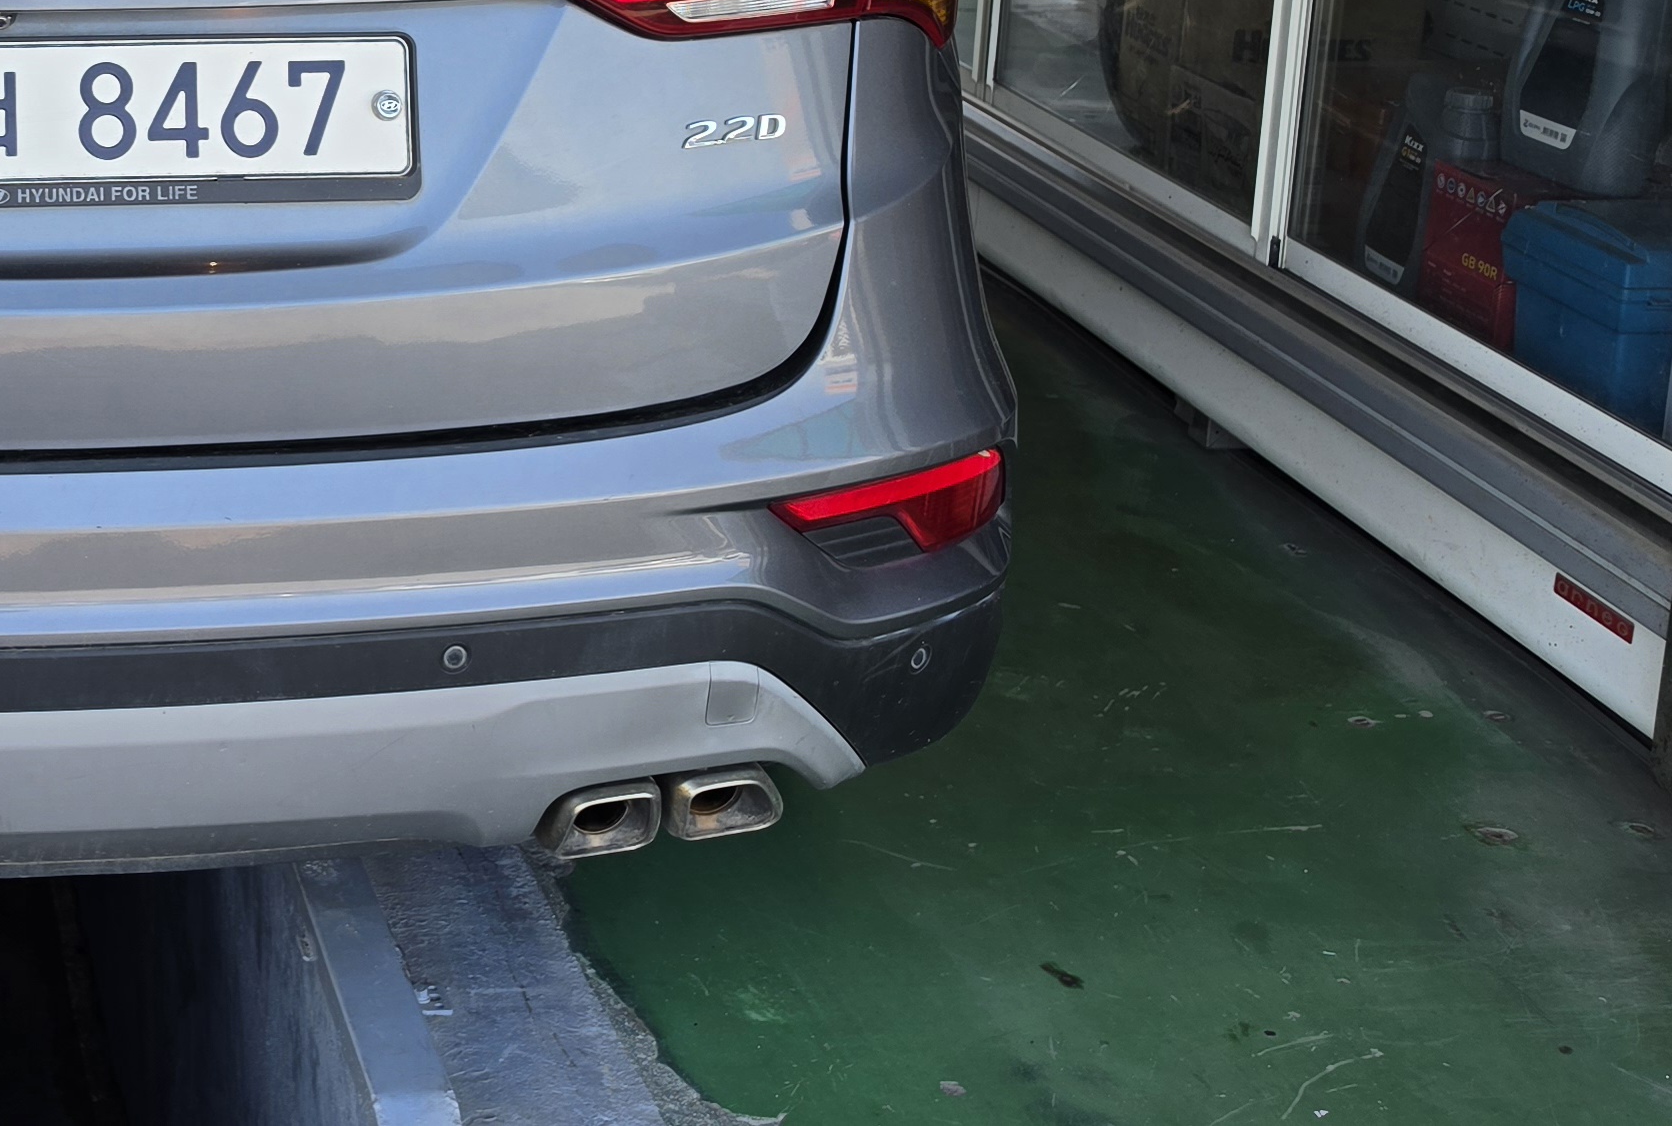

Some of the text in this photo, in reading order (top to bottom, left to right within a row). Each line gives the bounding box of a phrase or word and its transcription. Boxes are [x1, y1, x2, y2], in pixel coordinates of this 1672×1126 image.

[78, 60, 346, 161] 8467
[17, 185, 198, 203] HYUNDAI FOR LIFE
[1461, 252, 1498, 281] GB 90R
